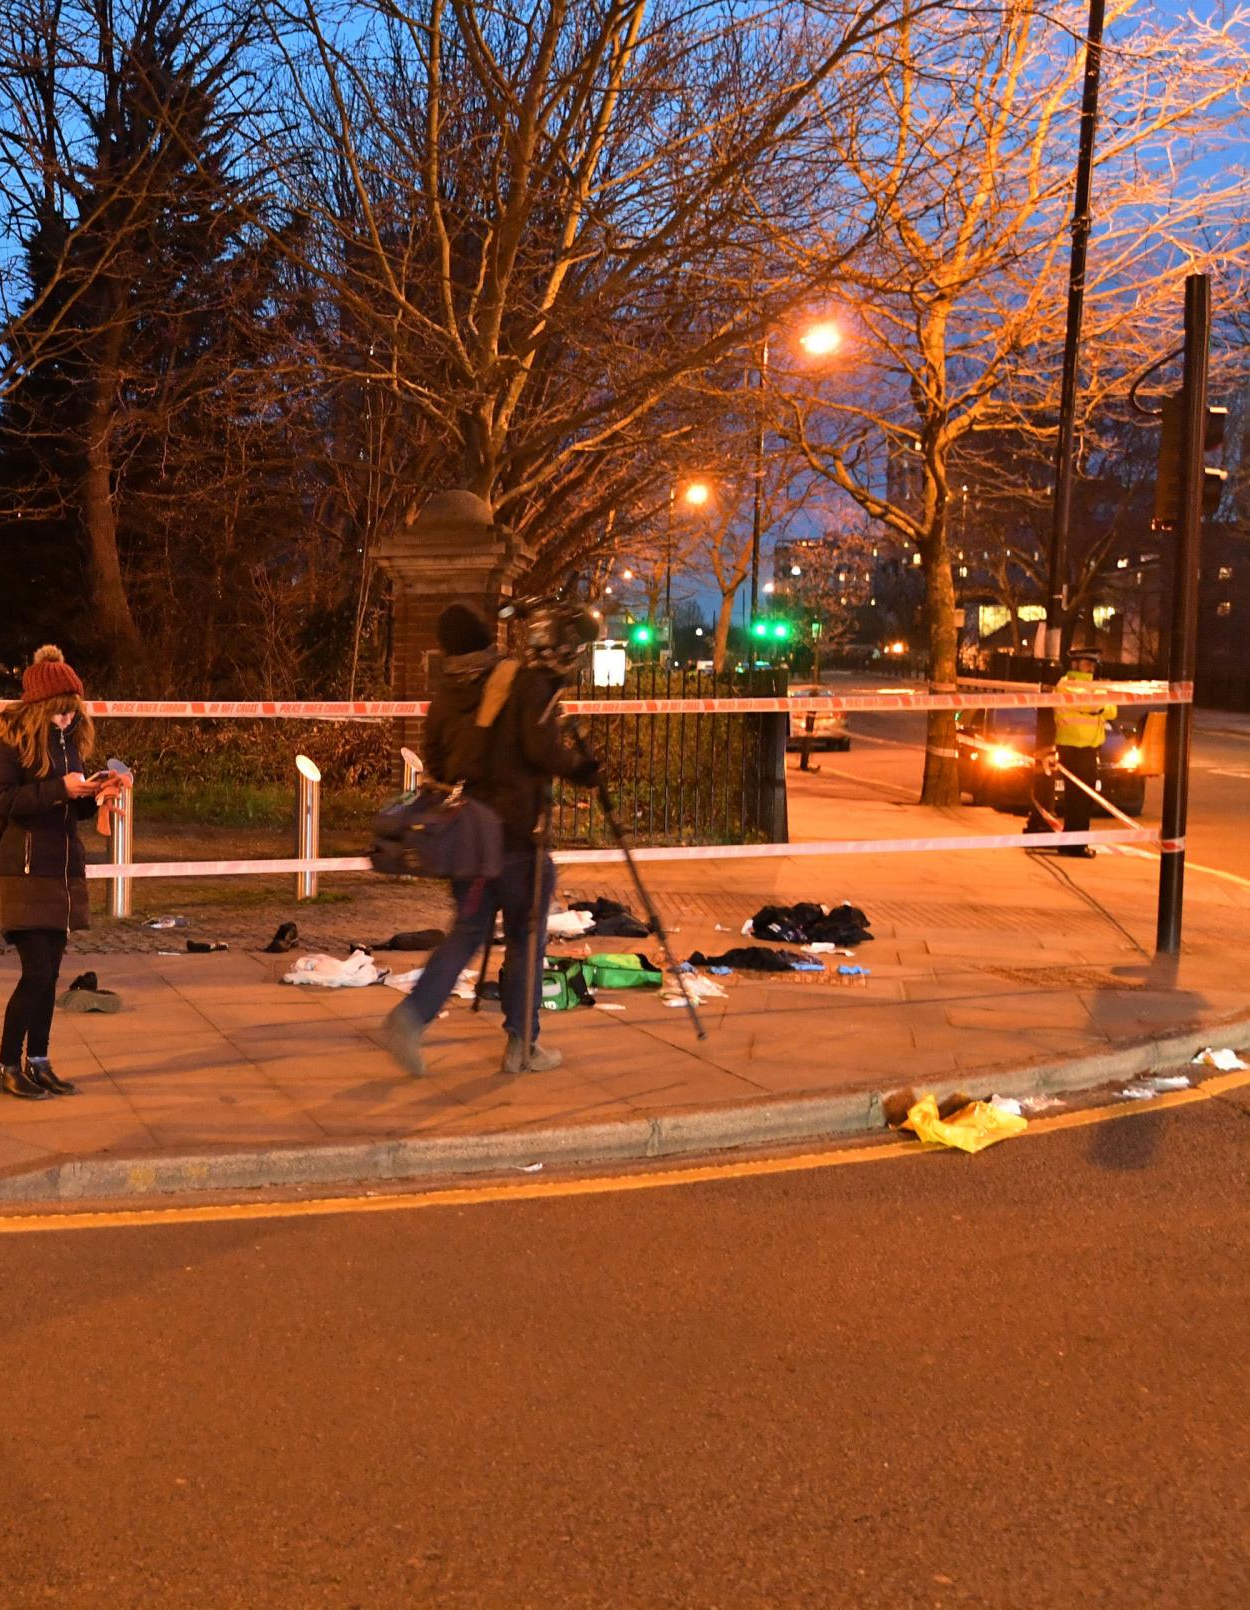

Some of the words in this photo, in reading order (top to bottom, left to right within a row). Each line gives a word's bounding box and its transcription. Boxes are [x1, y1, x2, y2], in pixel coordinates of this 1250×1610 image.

[111, 702, 131, 713] POLICE
[133, 702, 154, 713] INNER
[156, 702, 187, 713] CORDON
[220, 703, 234, 713] NOT
[236, 703, 258, 713] CROSS
